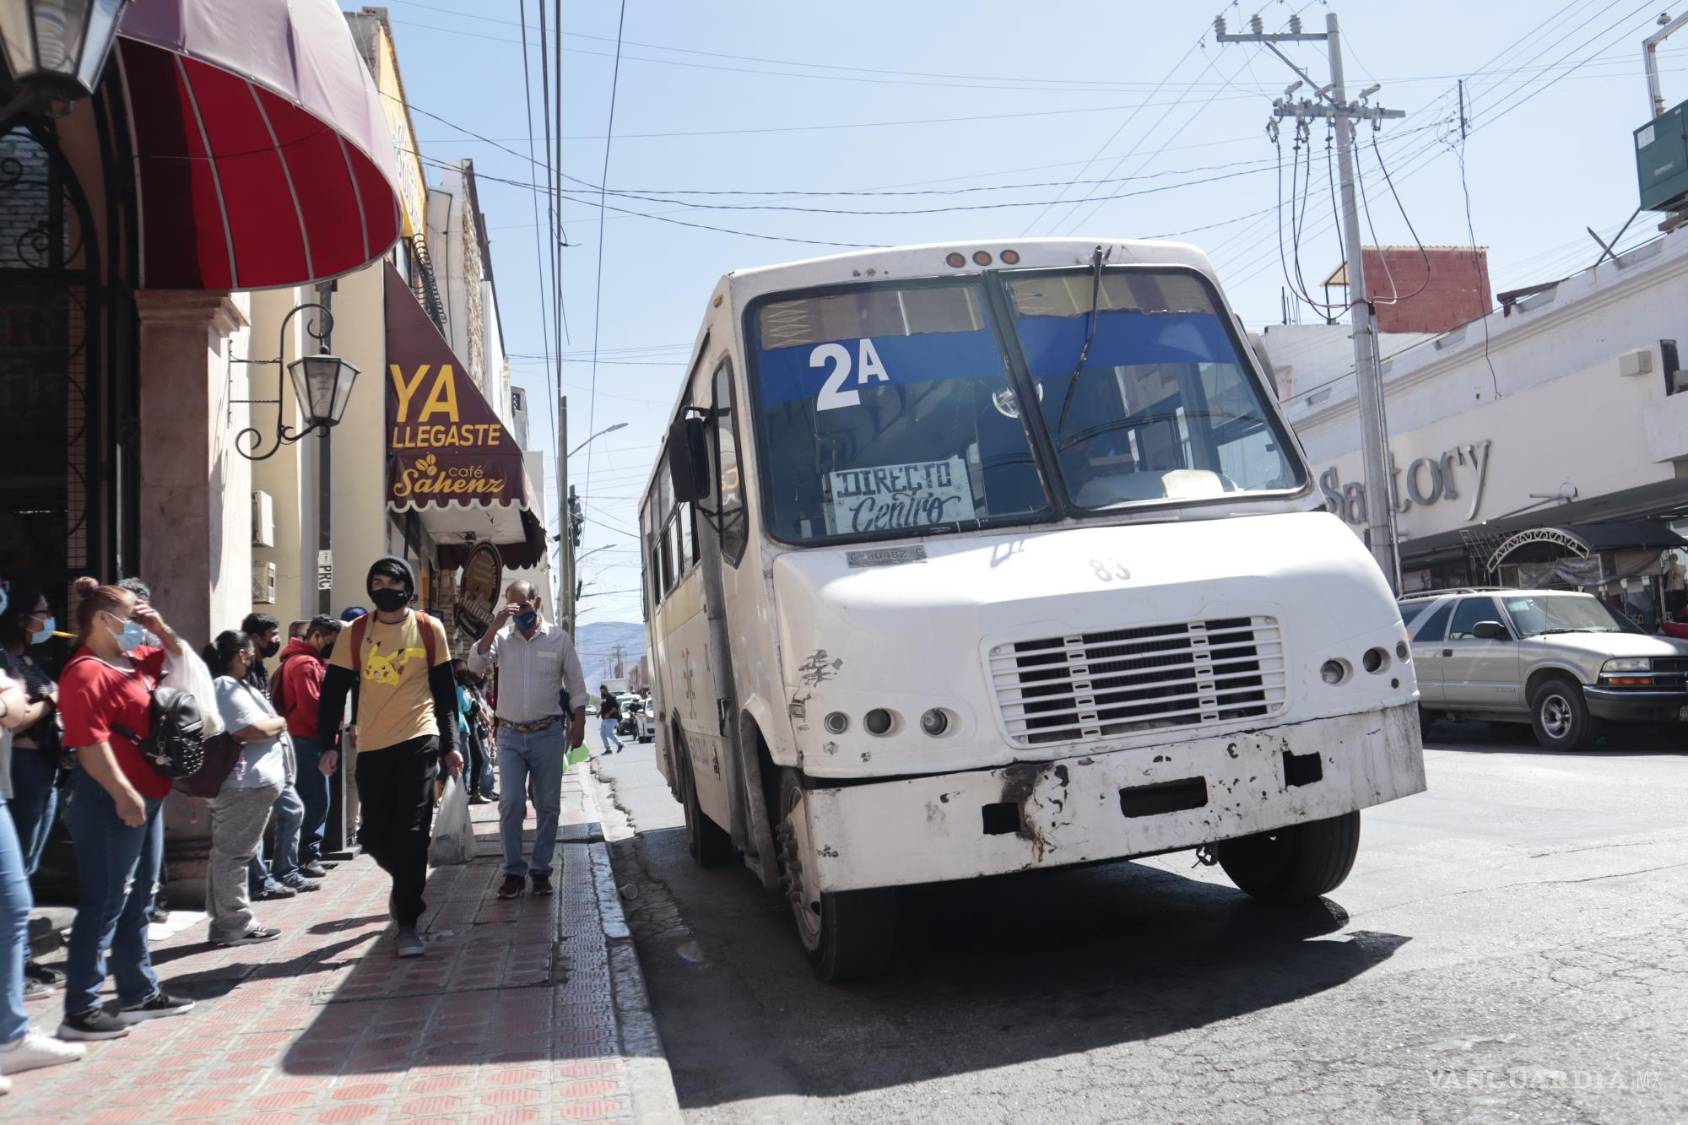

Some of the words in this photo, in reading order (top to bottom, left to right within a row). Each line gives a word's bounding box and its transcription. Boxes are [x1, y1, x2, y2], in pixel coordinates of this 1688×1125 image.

[389, 364, 460, 422] YA
[809, 338, 890, 411] 2A
[392, 424, 501, 449] LLEGASTE
[393, 468, 505, 497] Sahenz
[448, 465, 484, 479] café
[836, 461, 952, 498] DIRECTO
[1319, 439, 1492, 525] Satory
